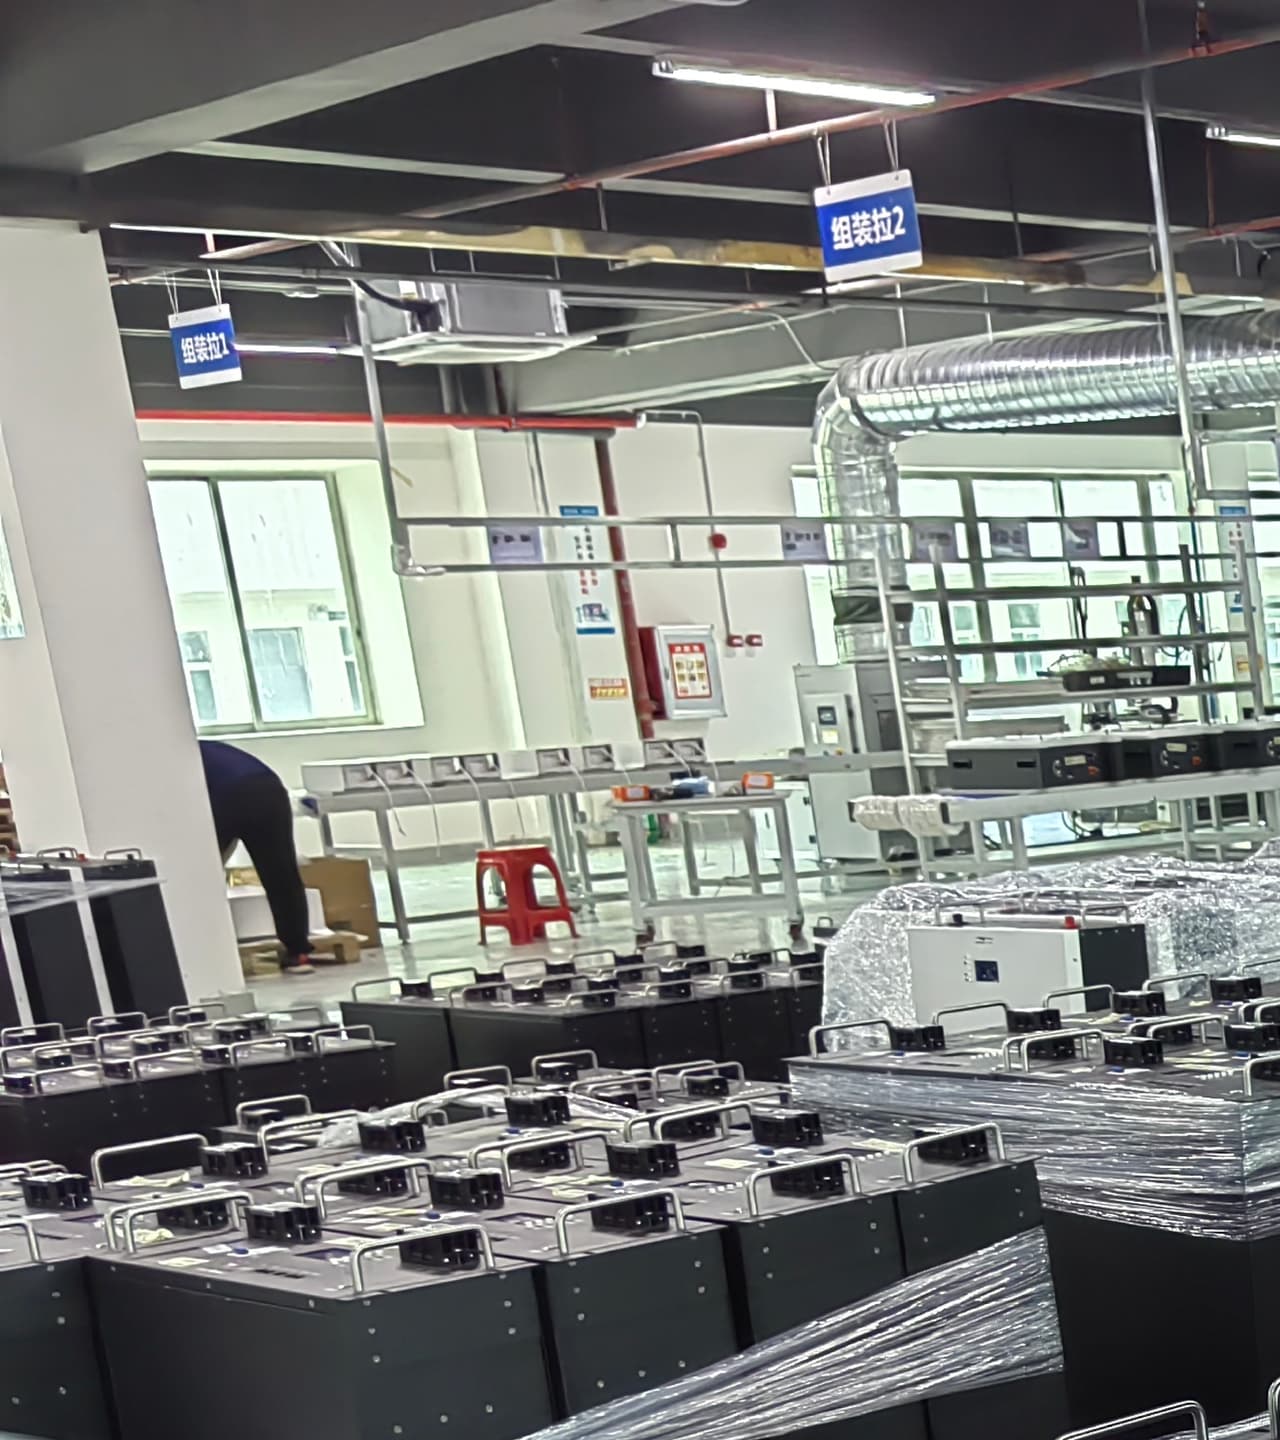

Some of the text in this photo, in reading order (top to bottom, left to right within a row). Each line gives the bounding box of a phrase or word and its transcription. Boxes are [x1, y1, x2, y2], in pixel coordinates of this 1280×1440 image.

[831, 206, 906, 251] 组装拉2
[181, 332, 230, 364] 组装拉1
